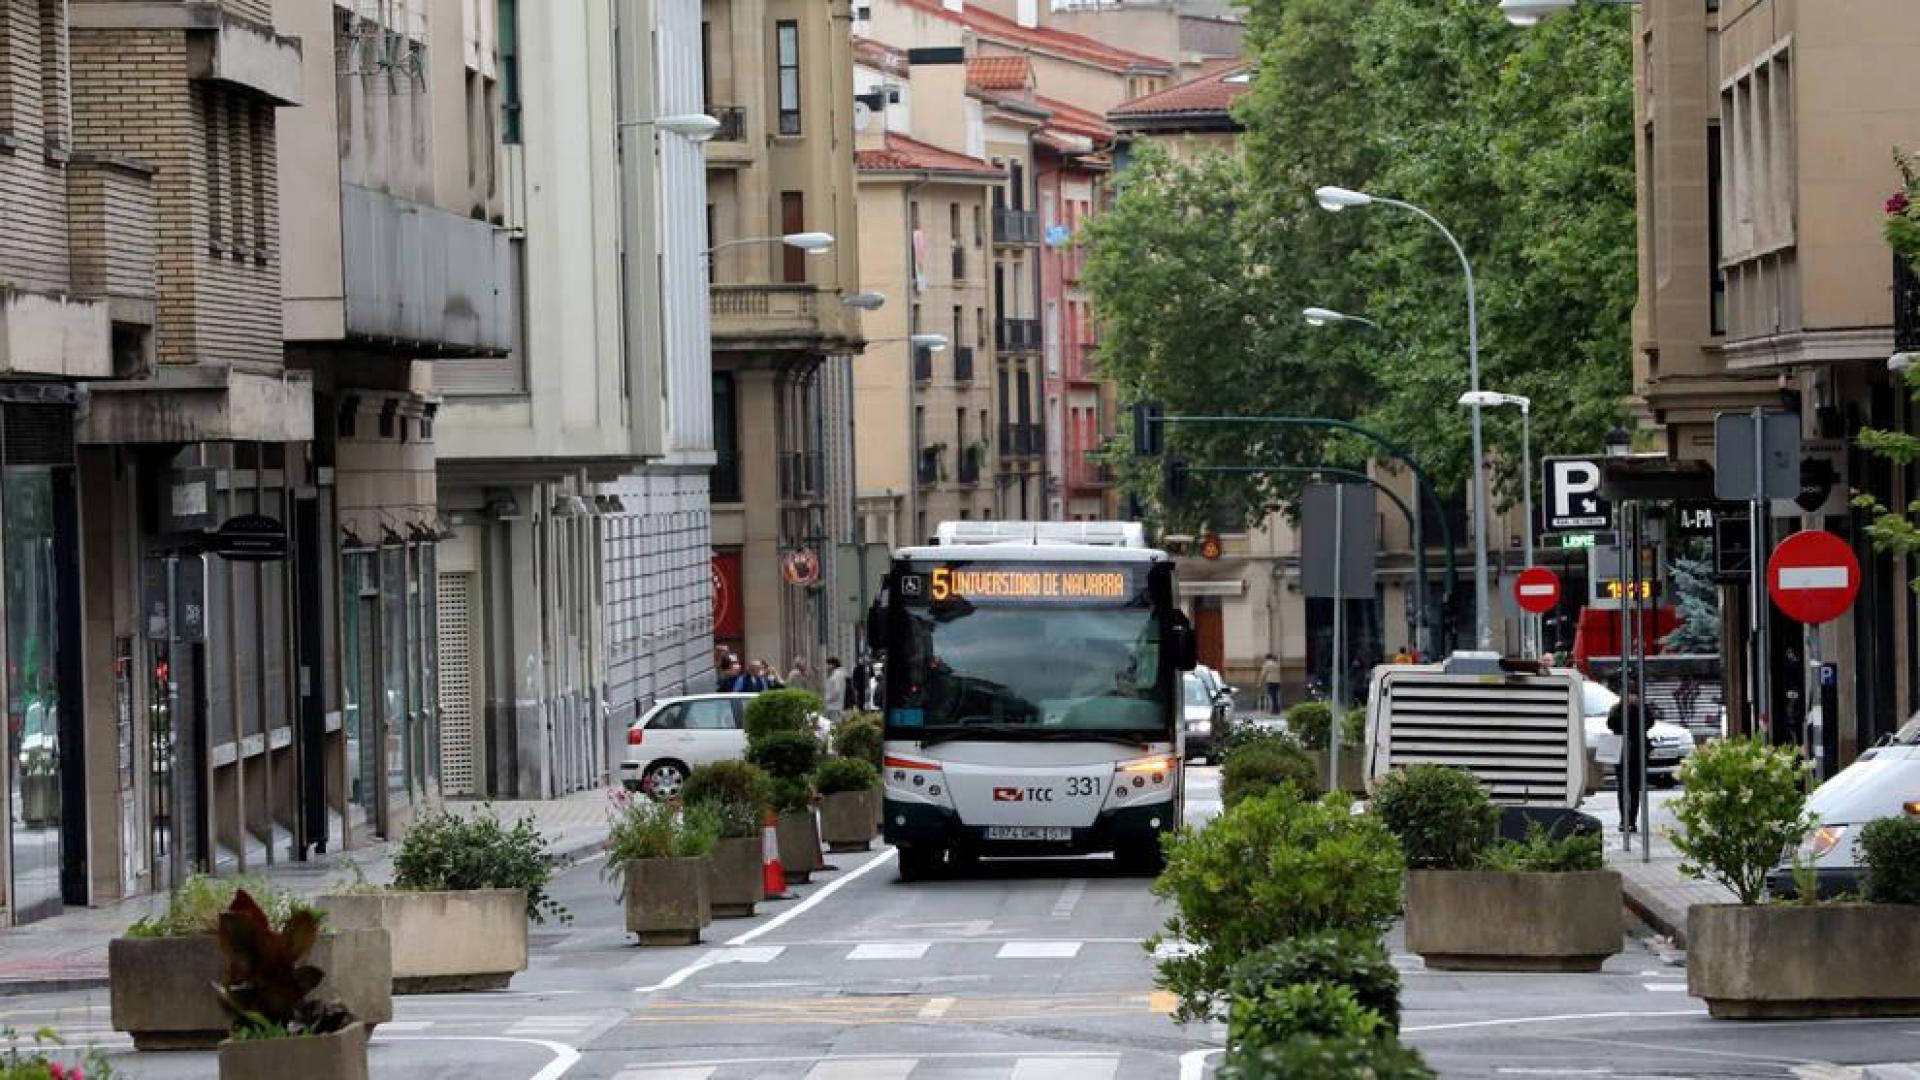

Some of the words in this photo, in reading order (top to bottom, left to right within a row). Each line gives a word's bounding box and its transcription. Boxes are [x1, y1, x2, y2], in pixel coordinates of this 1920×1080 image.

[1553, 460, 1600, 517] P
[932, 568, 950, 600] 5
[951, 571, 1040, 596] UNIVERSIDAD
[1044, 572, 1059, 597] DE
[1062, 572, 1124, 597] NAVARRA
[1820, 666, 1832, 684] P
[1026, 787, 1053, 802] TCC
[1066, 777, 1100, 796] 331
